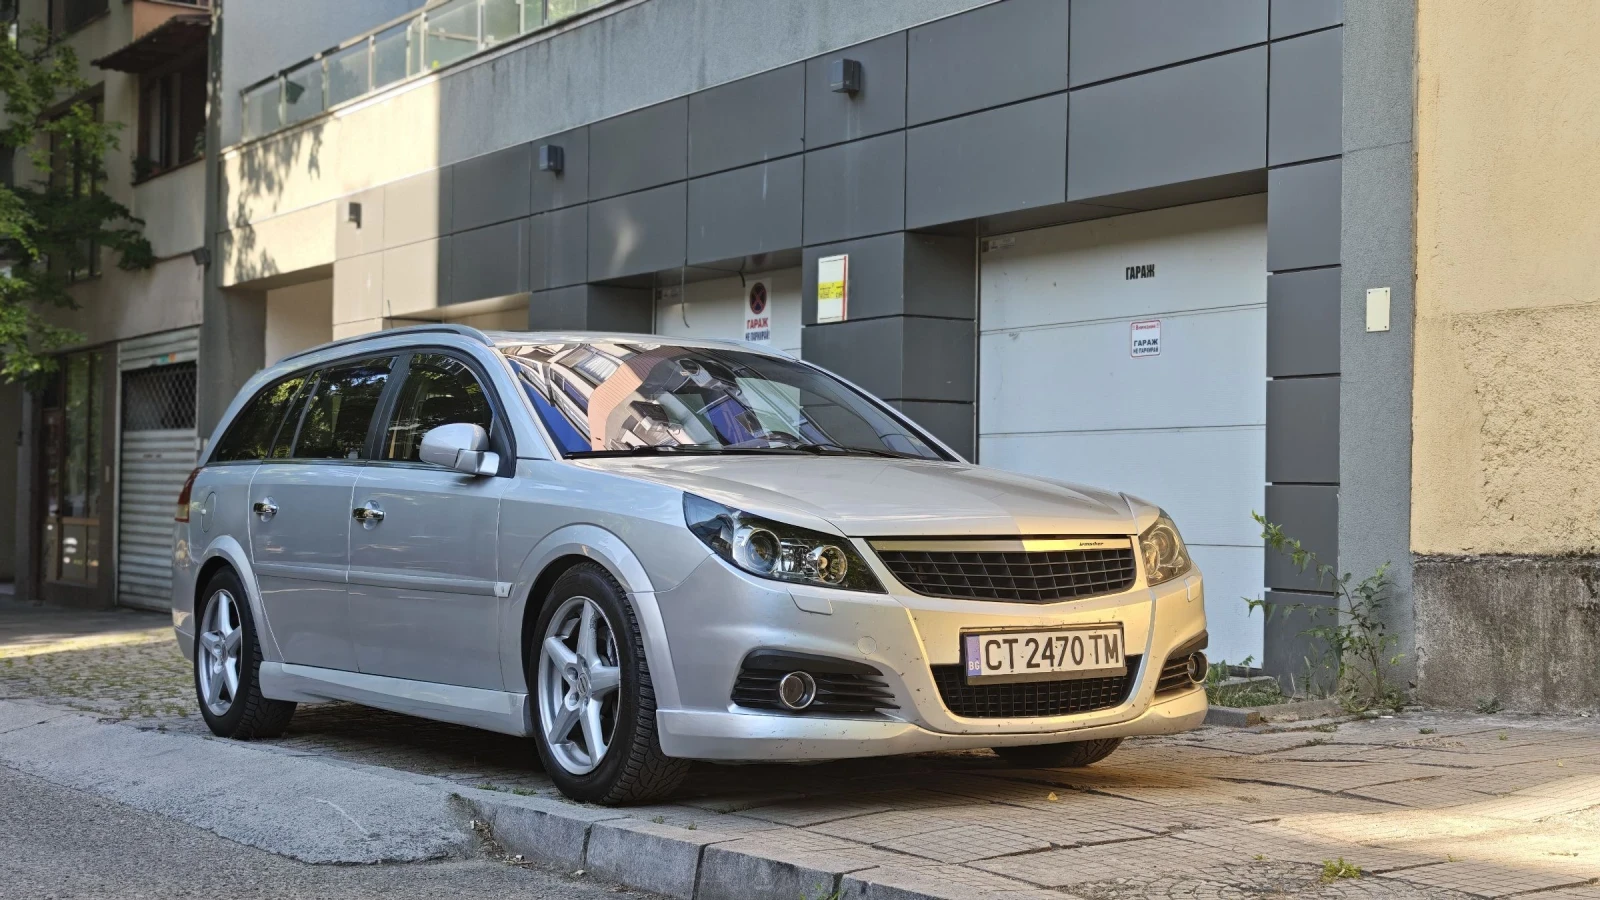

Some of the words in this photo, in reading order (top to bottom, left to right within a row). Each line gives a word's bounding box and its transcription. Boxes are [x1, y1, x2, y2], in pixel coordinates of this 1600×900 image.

[1125, 263, 1155, 281] ГАРАЖ
[746, 317, 769, 330] ГАРАЖ
[1133, 338, 1159, 347] ГАРАЖ
[985, 638, 1019, 671] CT
[1024, 635, 1085, 669] 2470
[1088, 633, 1119, 665] TM
[968, 661, 980, 671] BG
